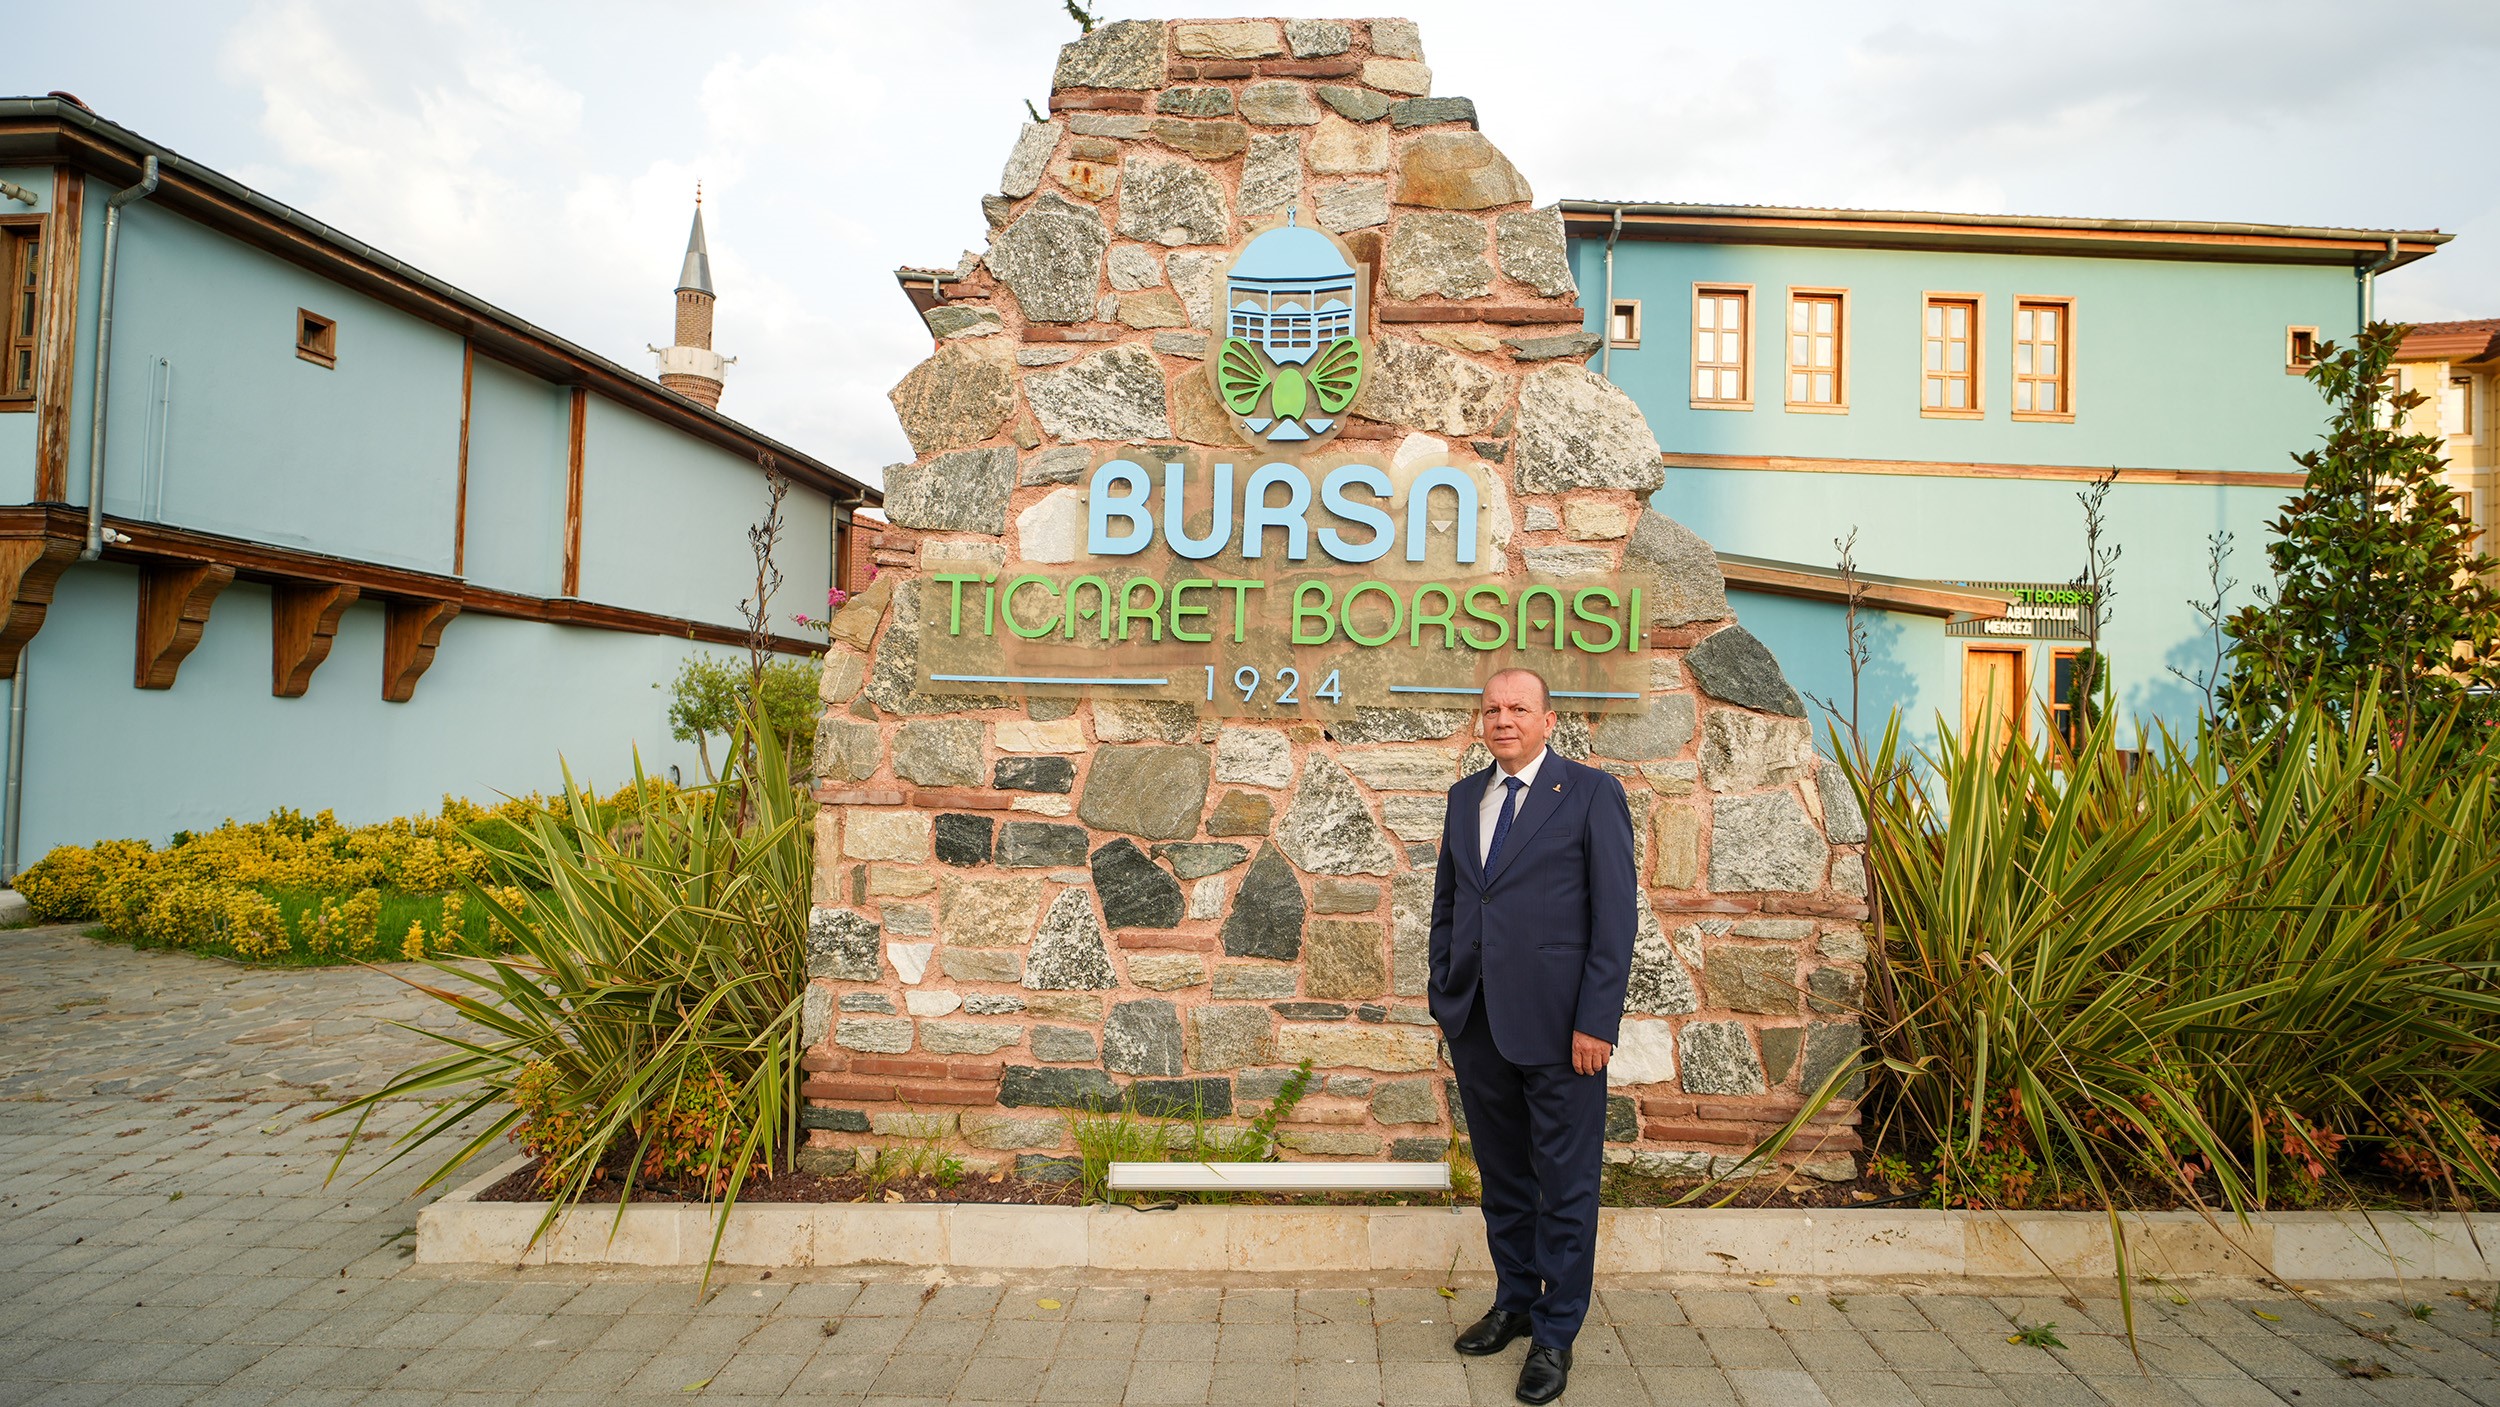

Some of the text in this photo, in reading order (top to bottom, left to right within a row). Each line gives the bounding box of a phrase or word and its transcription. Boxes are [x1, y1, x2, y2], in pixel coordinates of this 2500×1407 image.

[1088, 459, 1478, 564] BURSA
[1292, 580, 1641, 653] BORSASI
[2006, 606, 2079, 621] ABULUCULUK
[2035, 589, 2095, 605] BORSAS
[1205, 665, 1342, 705] 1924
